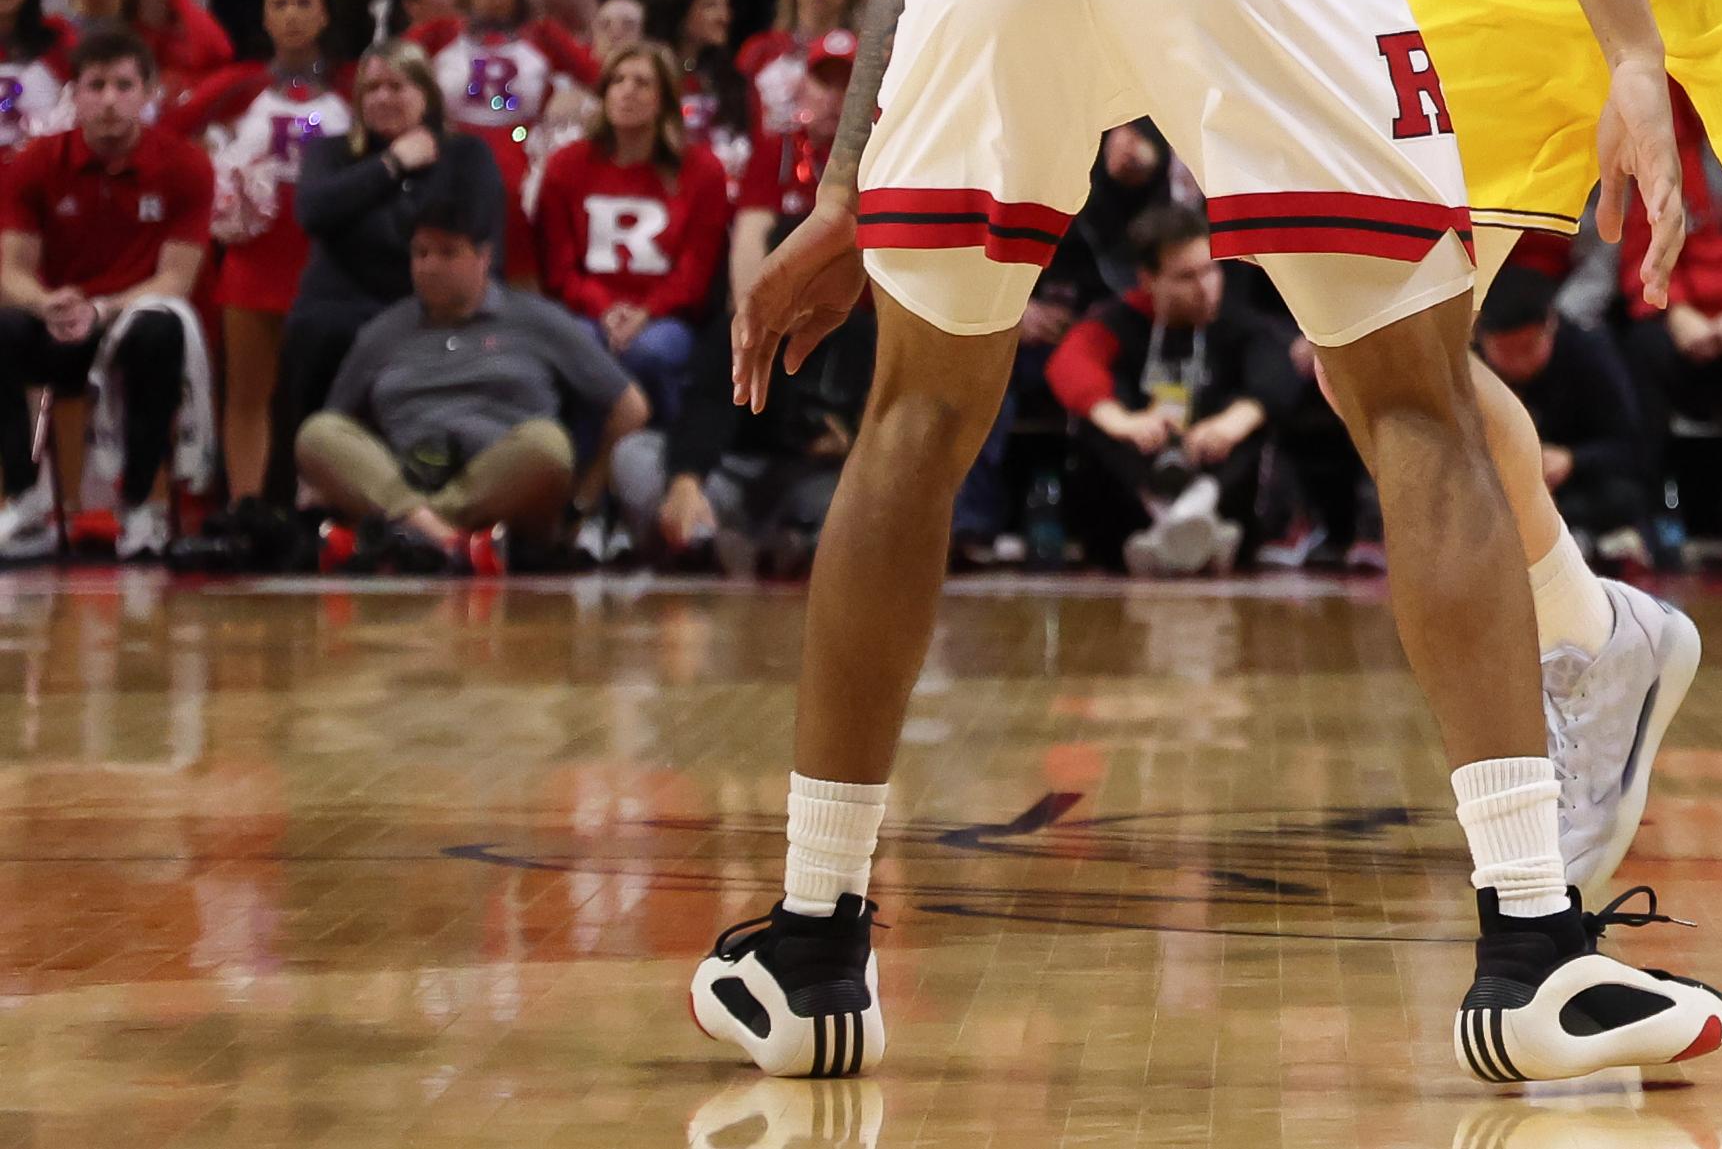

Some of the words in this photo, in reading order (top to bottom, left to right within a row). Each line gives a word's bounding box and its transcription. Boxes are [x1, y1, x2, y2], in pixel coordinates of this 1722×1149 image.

[468, 56, 519, 106] R
[1374, 29, 1456, 140] R
[582, 194, 672, 276] R
